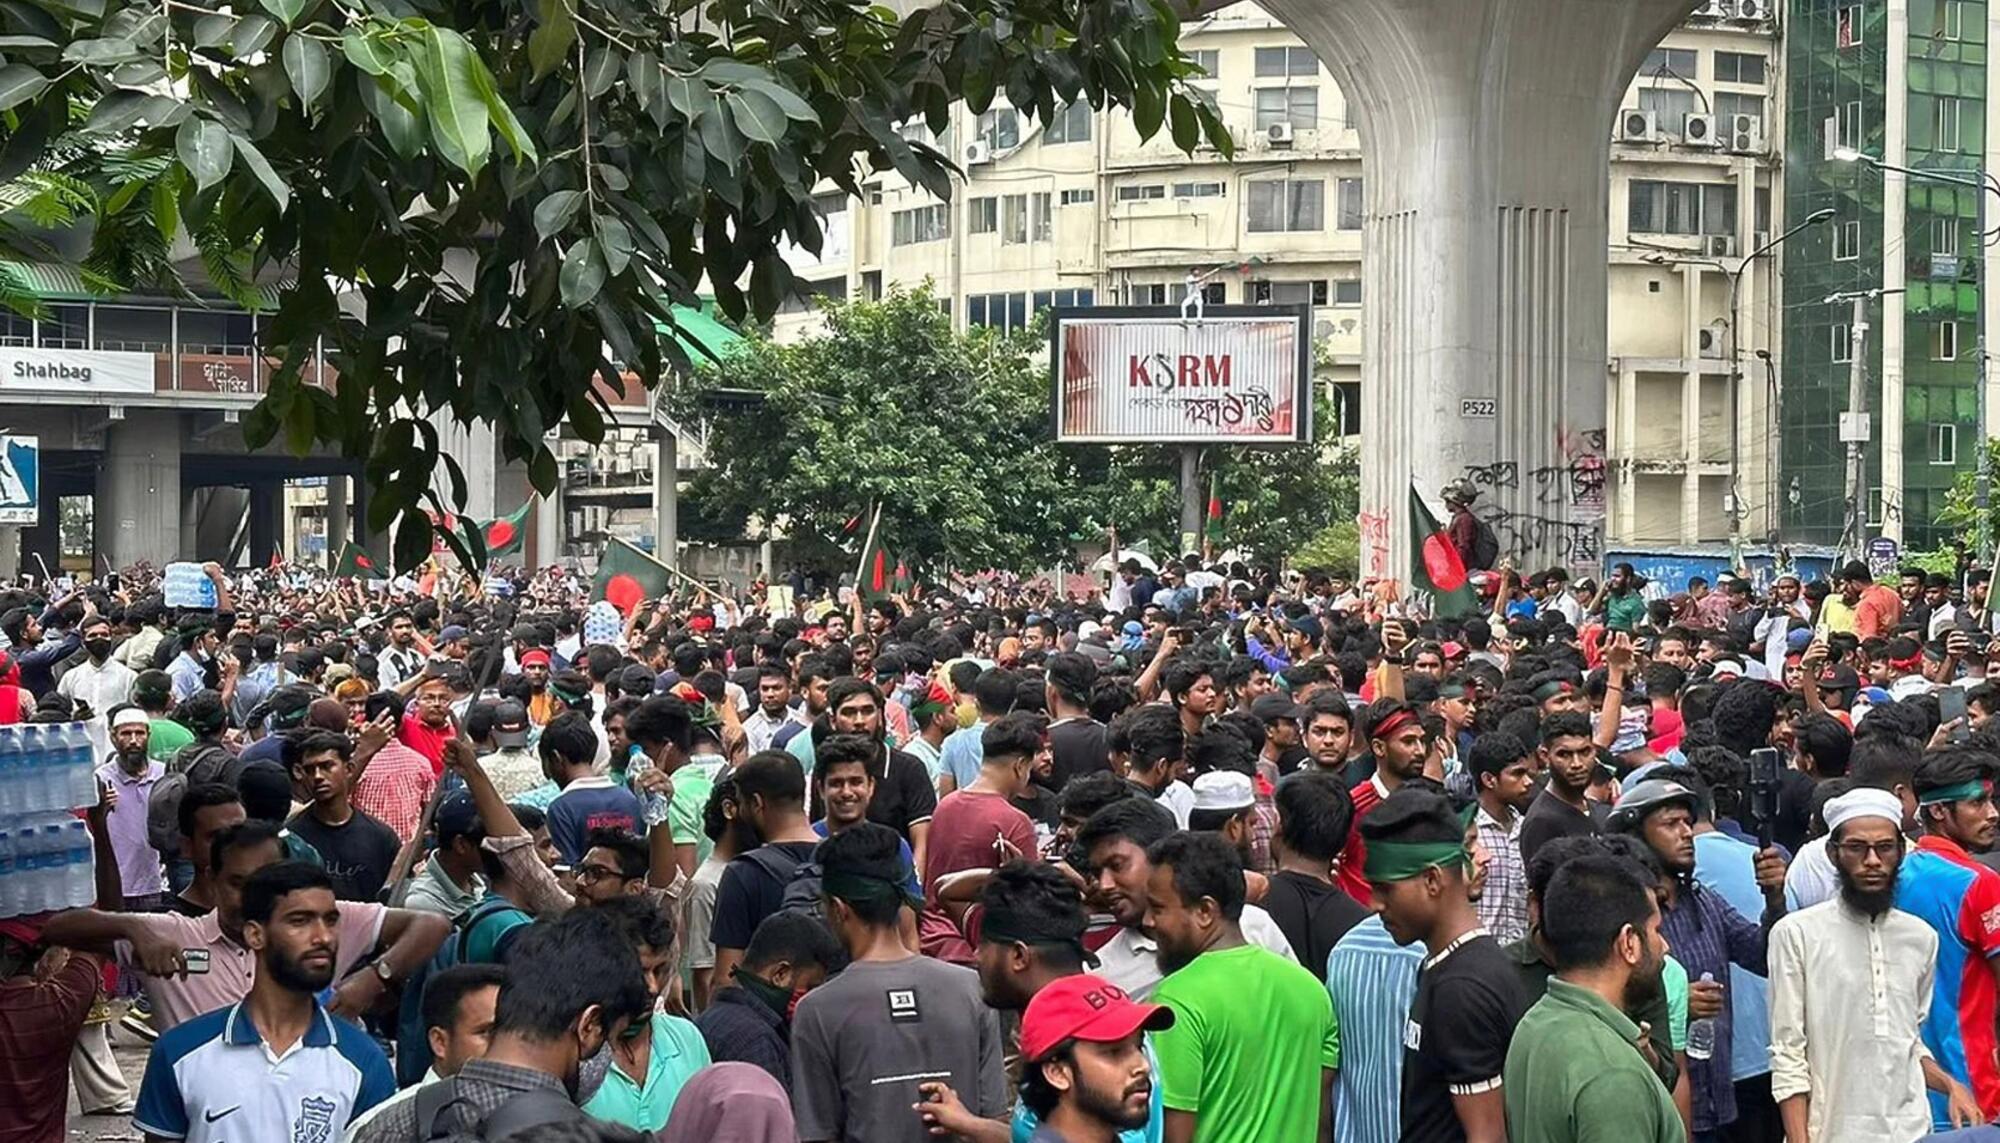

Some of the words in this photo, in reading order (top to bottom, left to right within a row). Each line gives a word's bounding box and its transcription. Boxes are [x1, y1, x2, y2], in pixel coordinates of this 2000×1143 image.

[14, 361, 92, 382] Shahbag
[1130, 353, 1231, 392] KSRM
[1462, 401, 1495, 415] P522
